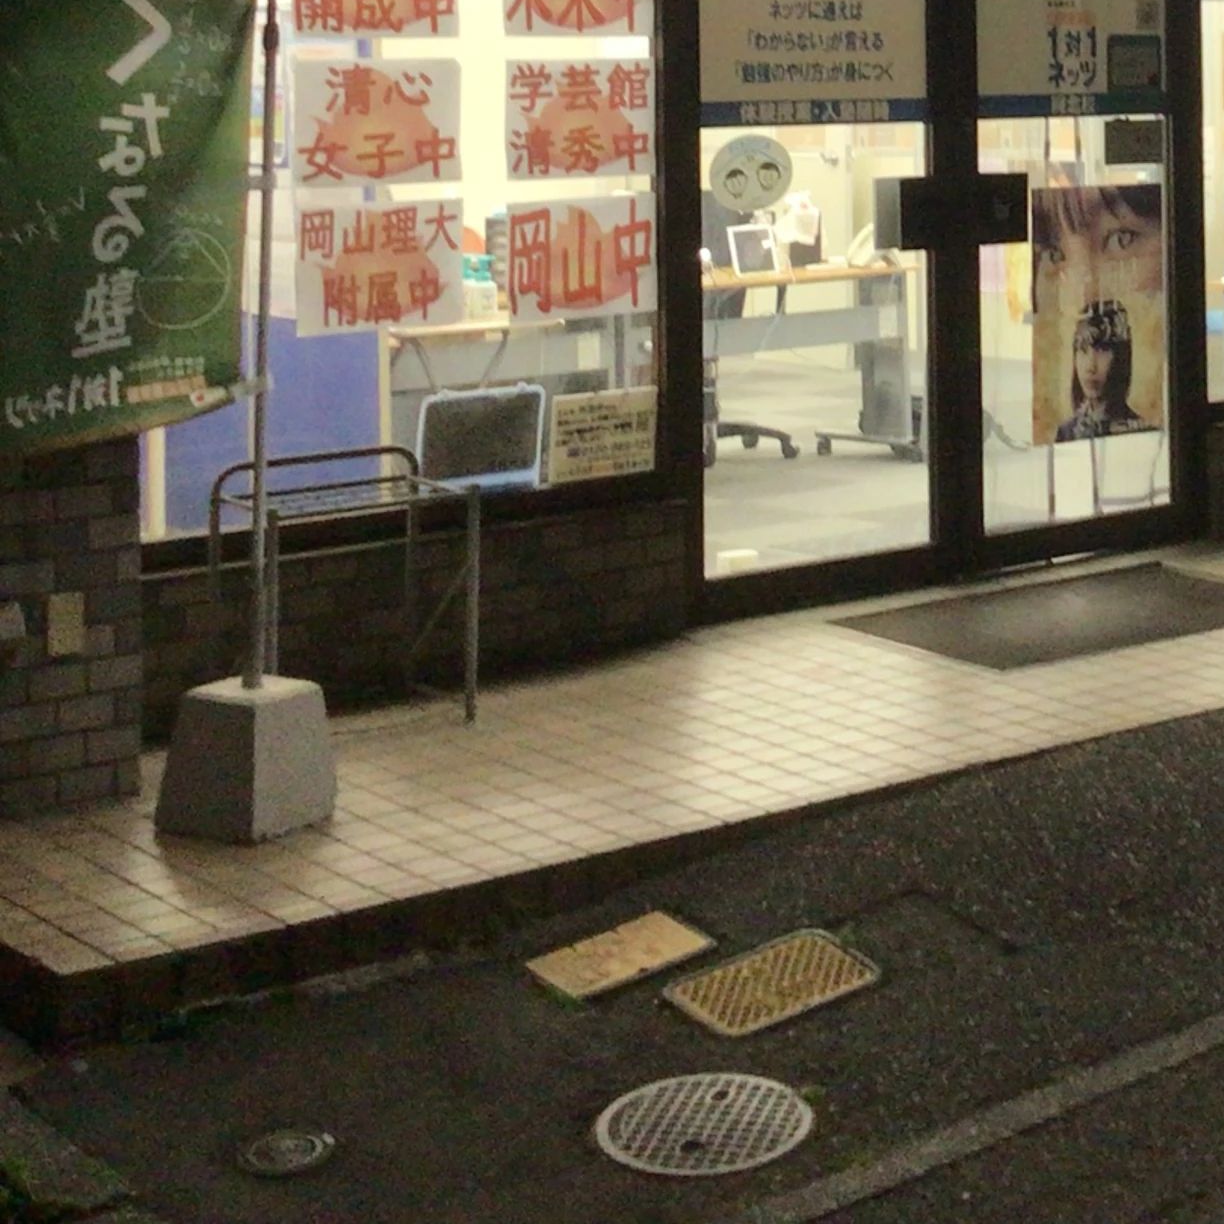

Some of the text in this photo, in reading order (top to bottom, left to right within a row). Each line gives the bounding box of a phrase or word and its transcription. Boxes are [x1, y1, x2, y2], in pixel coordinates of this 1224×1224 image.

[325, 63, 433, 117] 清心
[509, 62, 651, 113] 学芸館
[299, 125, 457, 182] 女子中
[509, 124, 650, 176] 清秀中
[300, 203, 459, 262] 岡山理大
[508, 198, 652, 316] 岡山中
[322, 269, 443, 327] 附属中
